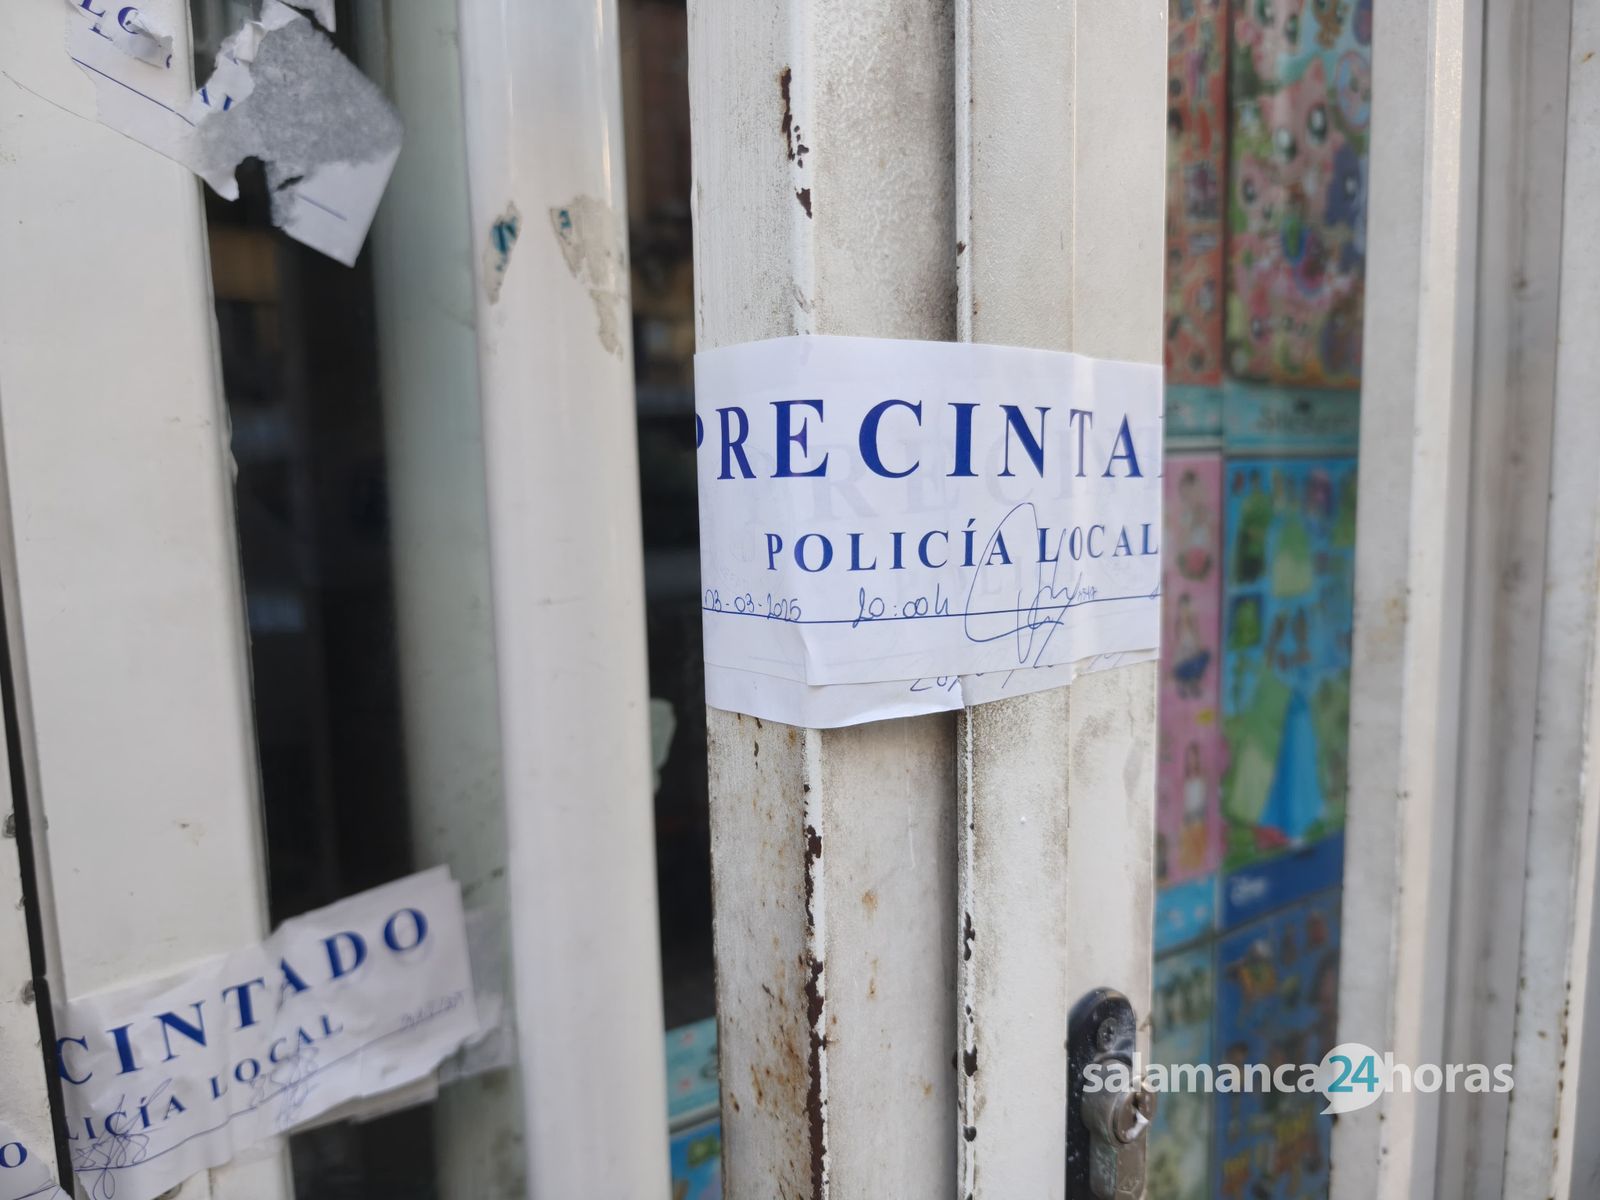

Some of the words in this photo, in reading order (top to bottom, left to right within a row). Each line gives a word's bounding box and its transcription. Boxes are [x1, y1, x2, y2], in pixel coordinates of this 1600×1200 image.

[695, 399, 1164, 480] RECINTA
[764, 518, 1013, 573] POLICÍA
[1036, 523, 1159, 563] LOCAL
[56, 907, 428, 1085] CINTADO
[209, 1013, 344, 1100] LOCAL
